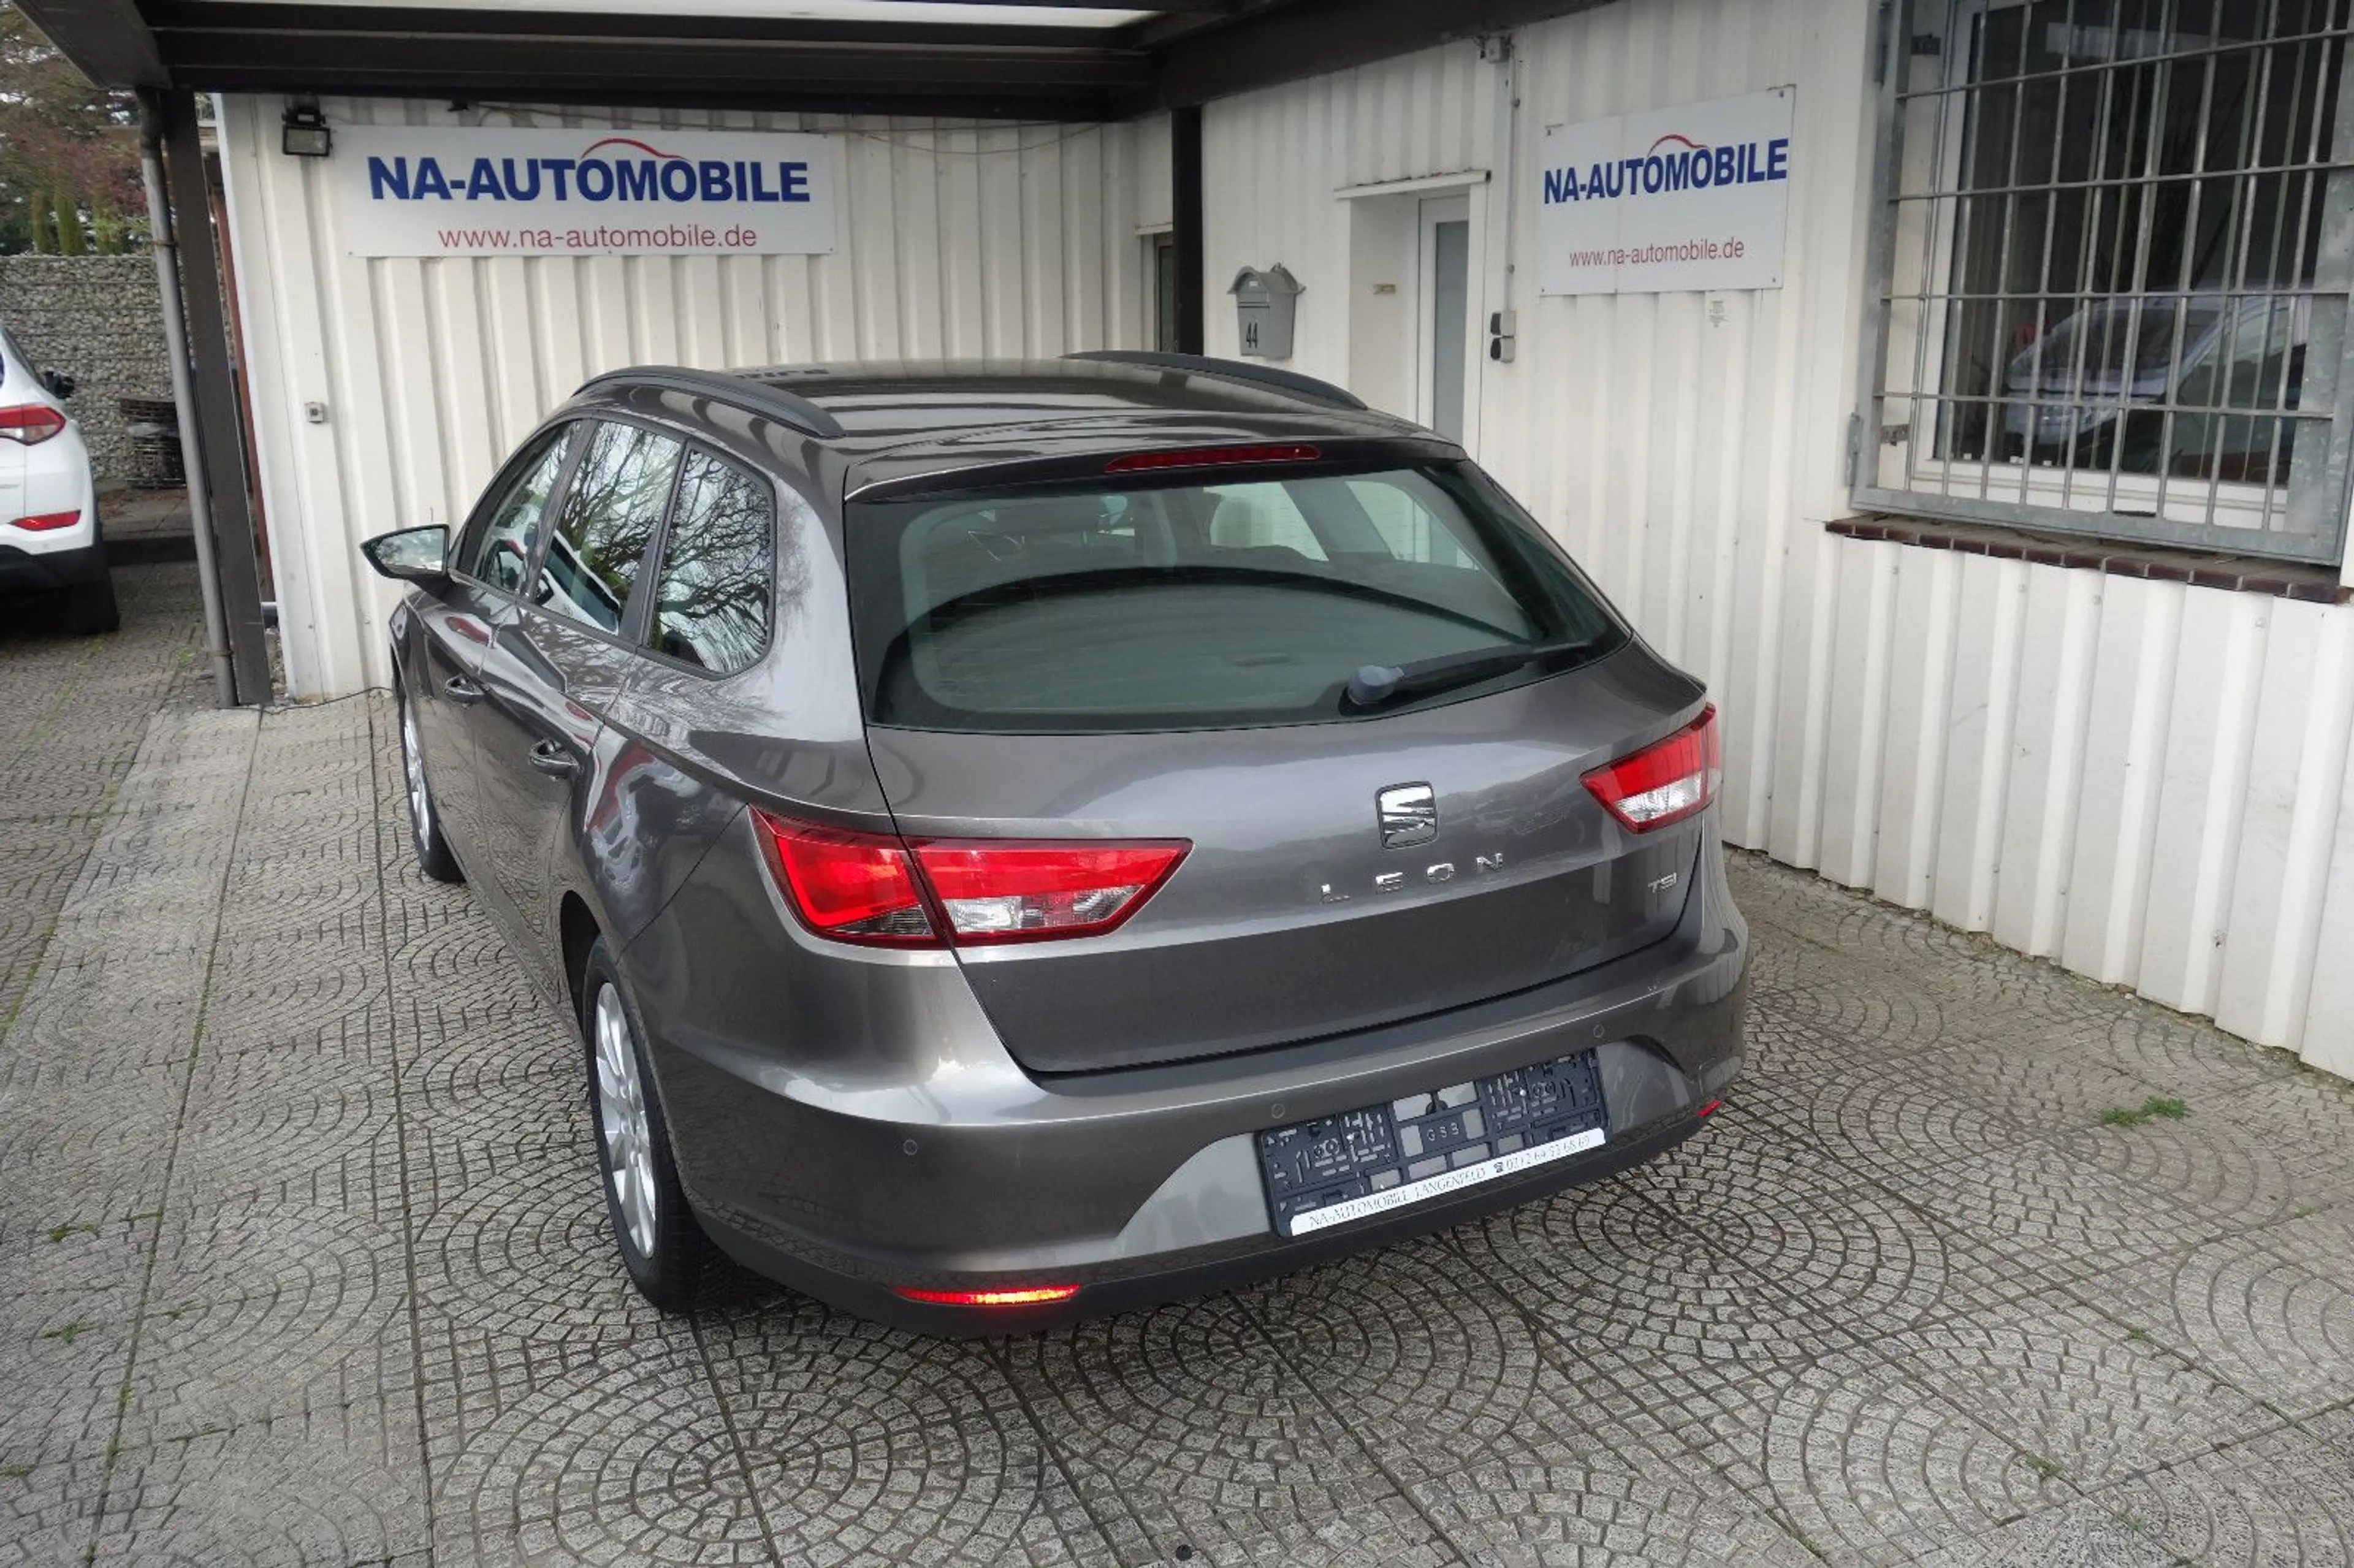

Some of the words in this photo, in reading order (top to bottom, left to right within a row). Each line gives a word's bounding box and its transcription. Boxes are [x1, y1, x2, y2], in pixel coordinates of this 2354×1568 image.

[368, 156, 810, 202] NA-AUTOMOBILE
[1544, 138, 1789, 204] NA-AUTOMOBILE
[438, 223, 757, 248] www.na-automobile.de
[1569, 237, 1745, 268] www.na-automobile.de
[1246, 321, 1258, 349] 44
[1320, 853, 1503, 904] LEON
